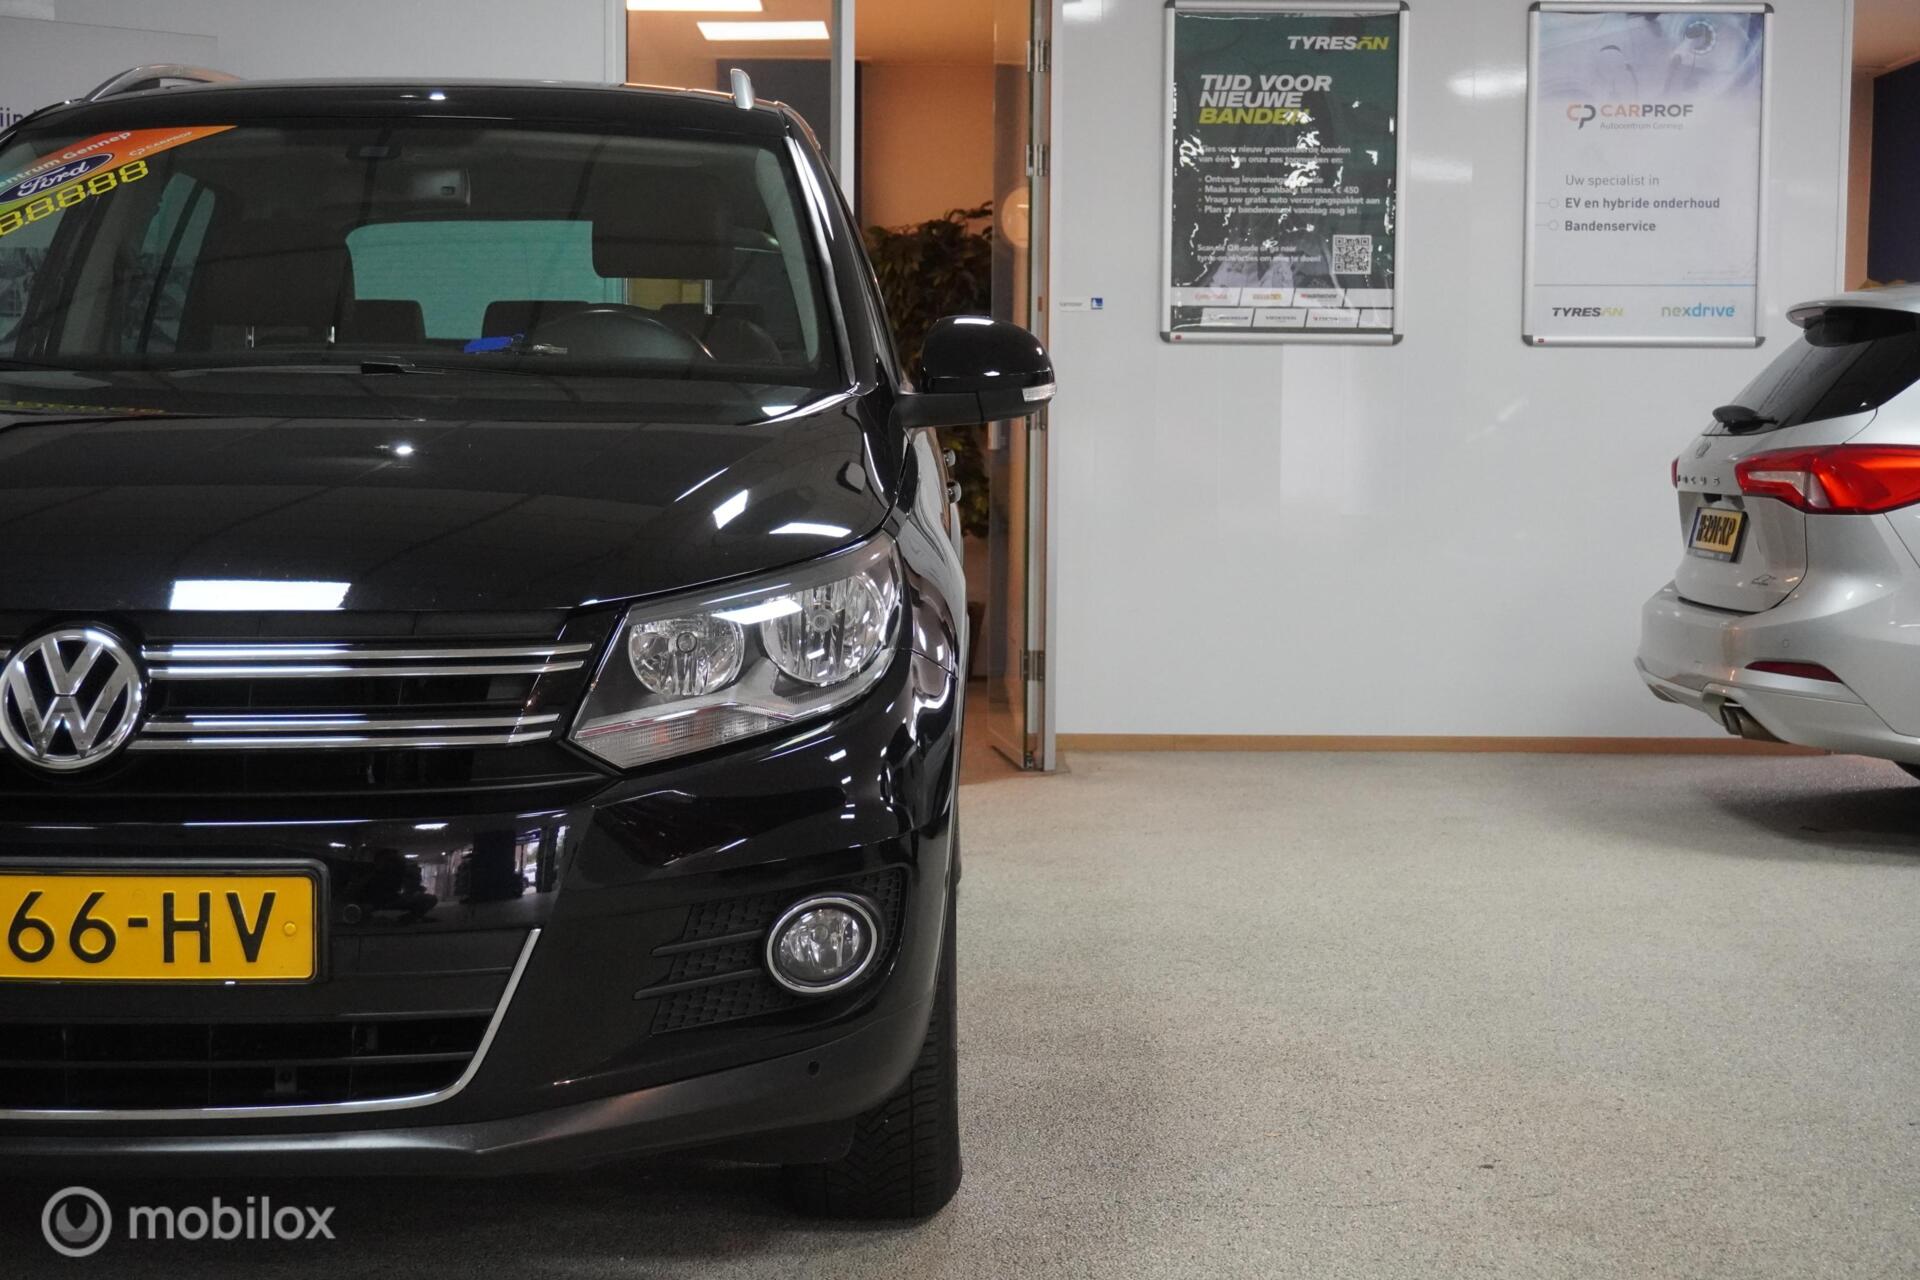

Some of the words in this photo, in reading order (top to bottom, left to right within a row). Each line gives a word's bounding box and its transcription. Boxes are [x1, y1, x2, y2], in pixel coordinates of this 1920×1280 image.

[1201, 74, 1251, 91] TIJD
[1259, 75, 1333, 91] VOOR
[1199, 91, 1304, 108] NIEUWE
[1600, 104, 1693, 118] CARPROF
[1600, 122, 1651, 130] Autocentrum
[62, 132, 132, 160] Gennep
[1238, 145, 1263, 153] nieuw
[1320, 145, 1351, 154] banden
[17, 161, 91, 198] Ford
[1204, 174, 1240, 185] Ontvang
[1565, 175, 1585, 186] Uw
[1588, 174, 1645, 188] specialist
[1649, 175, 1660, 186] in
[1204, 185, 1227, 193] Maak
[1229, 185, 1248, 193] kans
[1249, 186, 1260, 195] op
[1300, 186, 1313, 194] tot
[1204, 195, 1229, 205] Vraag
[1244, 195, 1268, 205] gratis
[1564, 197, 1581, 209] EV
[1584, 200, 1600, 209] en
[1603, 197, 1650, 212] hybride
[1653, 197, 1721, 209] onderhoud
[1204, 205, 1222, 213] Plan
[1293, 206, 1328, 216] vandaag
[1329, 208, 1346, 216] nog
[1564, 220, 1657, 232] Bandenservice
[1661, 302, 1736, 318] nexdrive
[8, 891, 277, 963] 66-HV
